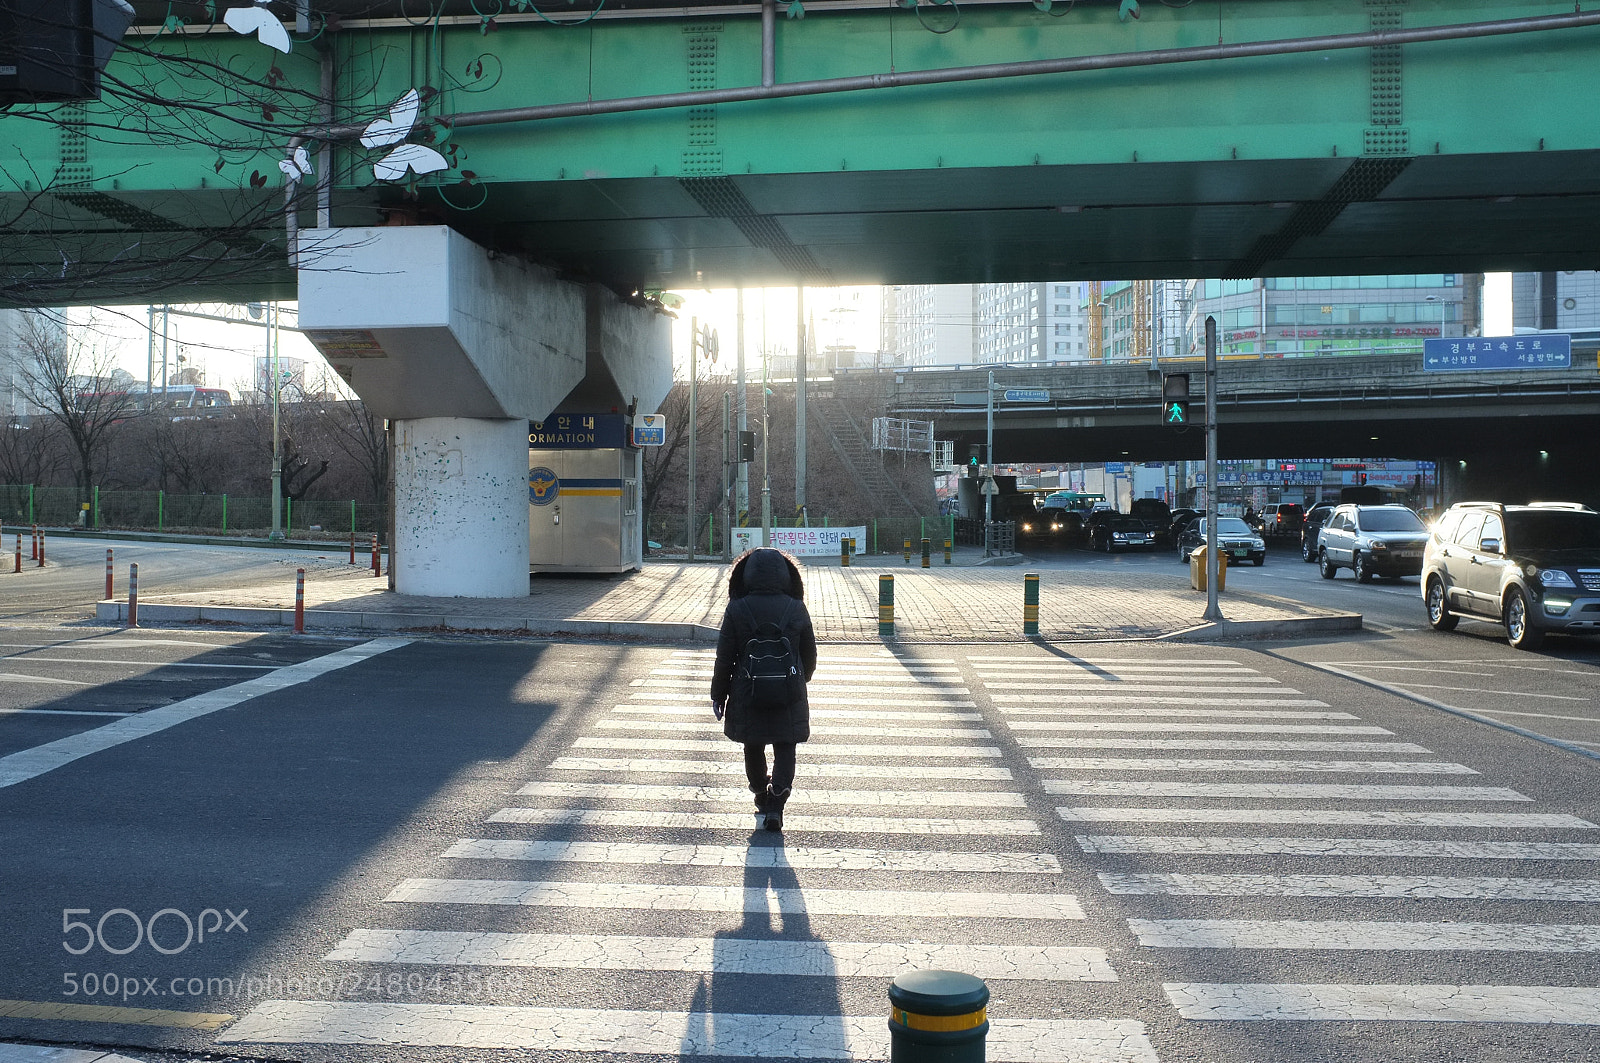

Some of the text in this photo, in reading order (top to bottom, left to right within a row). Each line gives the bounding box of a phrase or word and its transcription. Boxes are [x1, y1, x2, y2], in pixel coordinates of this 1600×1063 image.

[1450, 340, 1542, 353] 경부고속도로
[1441, 355, 1477, 364] 부산방면
[1517, 353, 1554, 363] 서울방면
[1369, 473, 1403, 482] Sewing
[1407, 473, 1436, 481] scool
